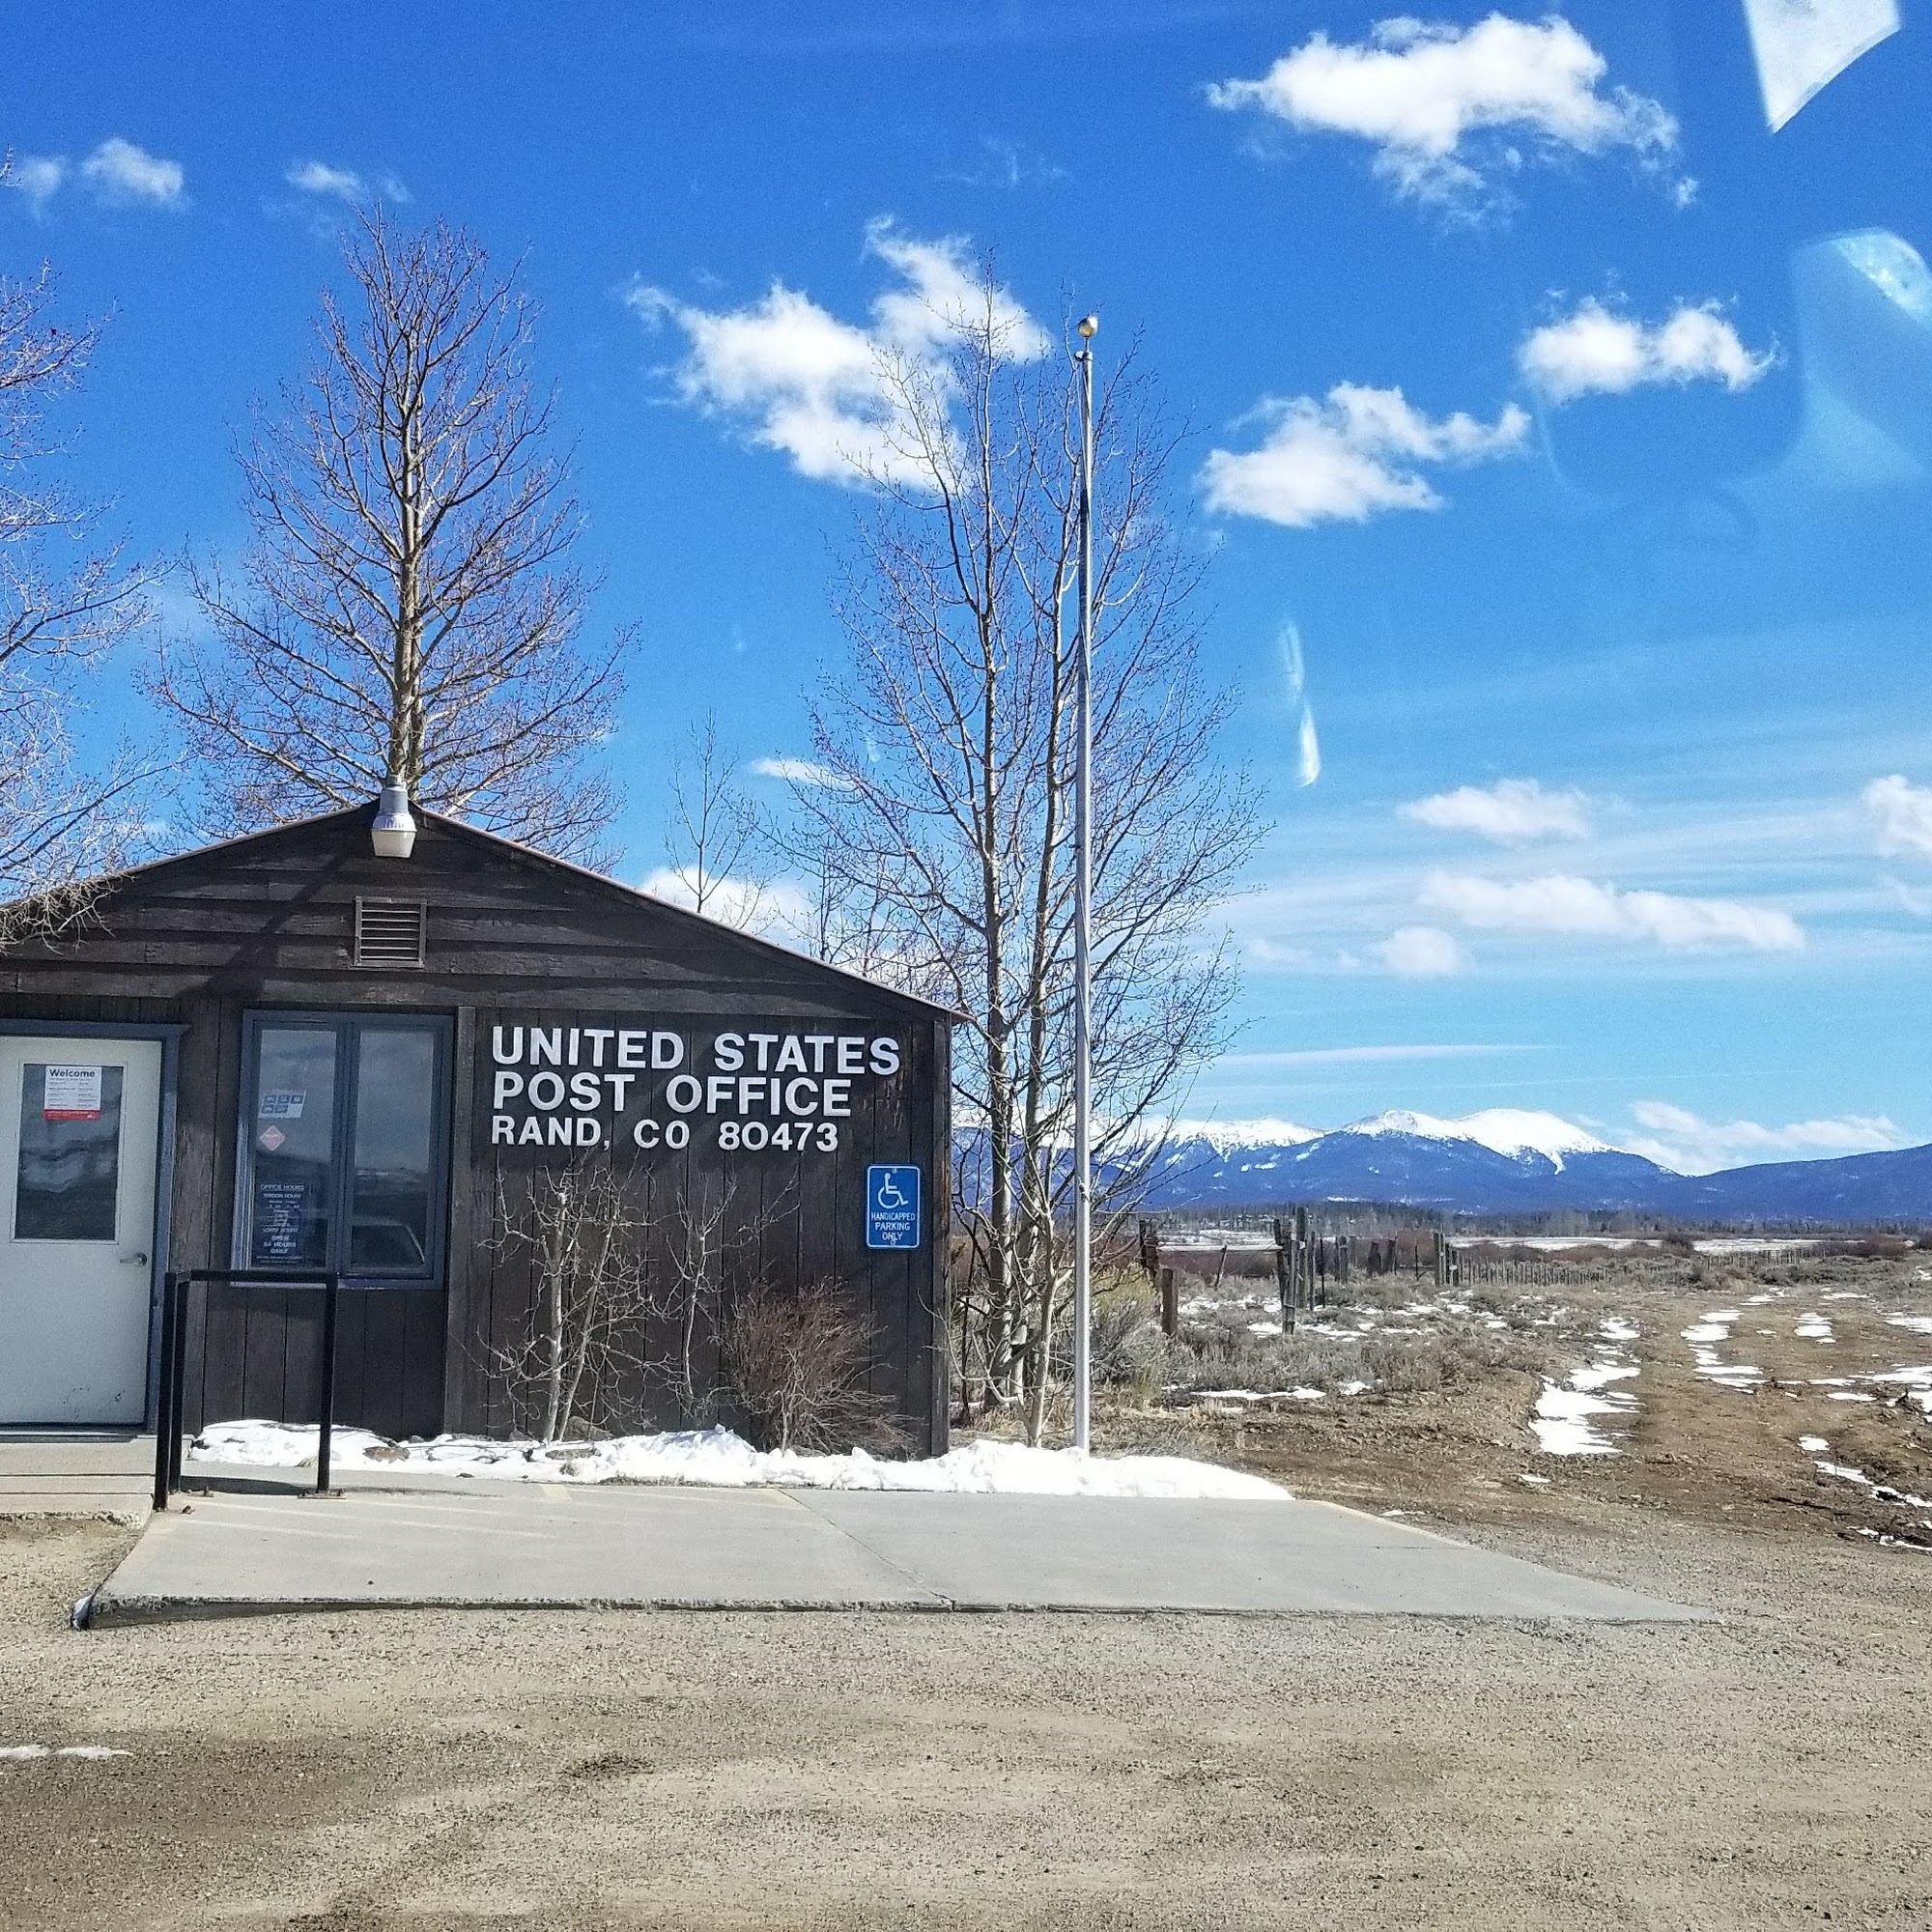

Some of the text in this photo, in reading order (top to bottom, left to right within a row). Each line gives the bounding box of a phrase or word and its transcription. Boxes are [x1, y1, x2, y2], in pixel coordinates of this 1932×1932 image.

[492, 1026, 900, 1075] UNITED STATES
[49, 1068, 96, 1077] Welcome
[493, 1070, 852, 1117] POST OFFICE
[491, 1115, 838, 1152] RAND, CO 80473
[870, 1211, 916, 1221] HANDICAPPED
[874, 1222, 911, 1232] PARKING
[882, 1232, 903, 1241] ONLY
